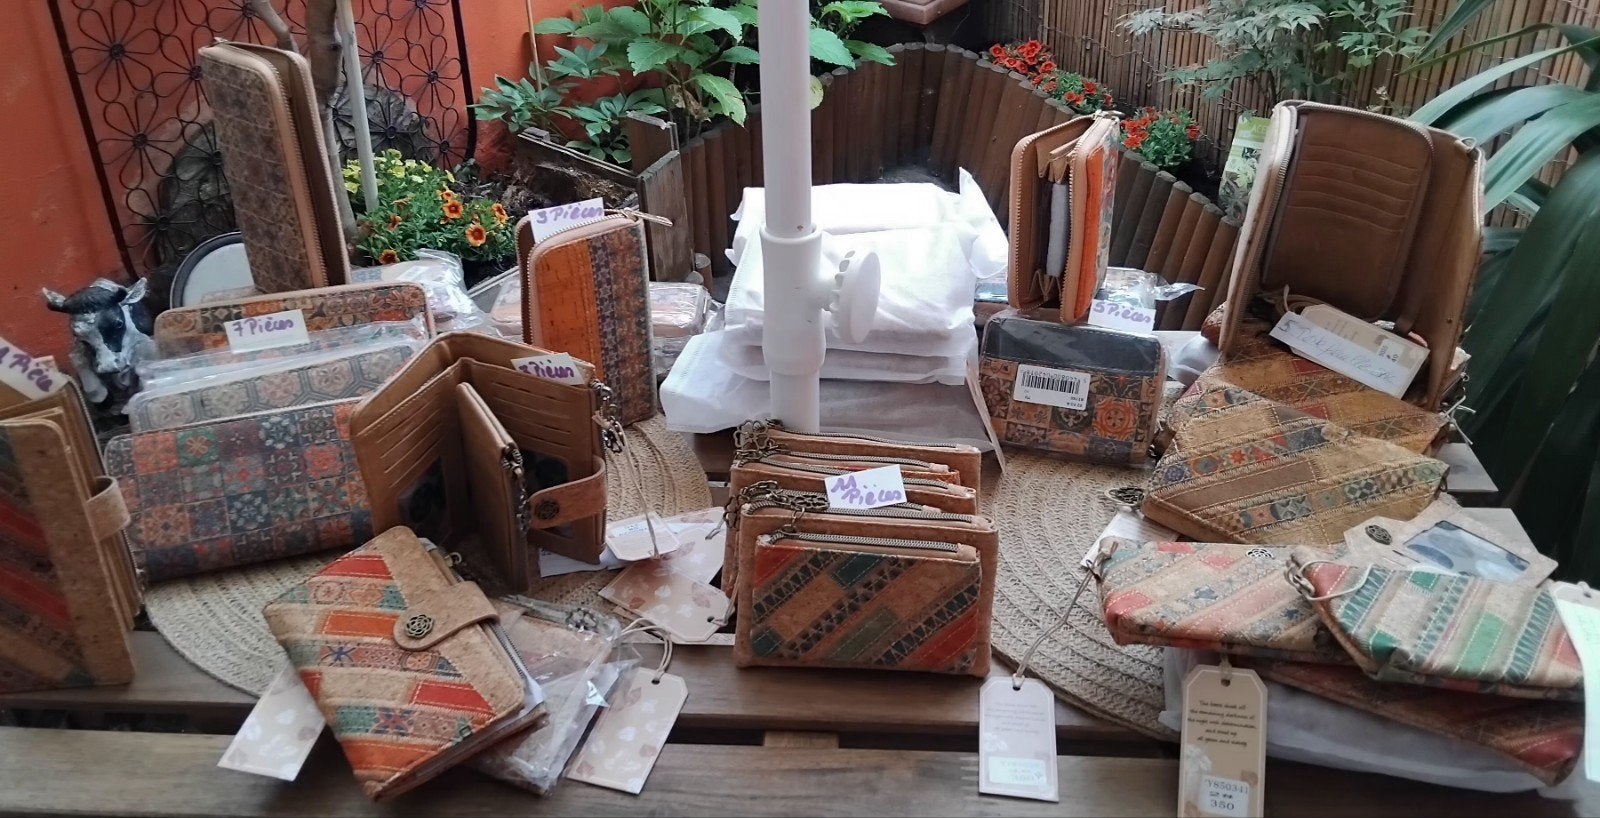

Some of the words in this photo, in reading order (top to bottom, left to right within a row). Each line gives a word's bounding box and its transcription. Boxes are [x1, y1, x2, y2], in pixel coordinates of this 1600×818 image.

[1093, 301, 1105, 313] 5
[232, 321, 244, 337] 7
[1277, 319, 1297, 333] 5
